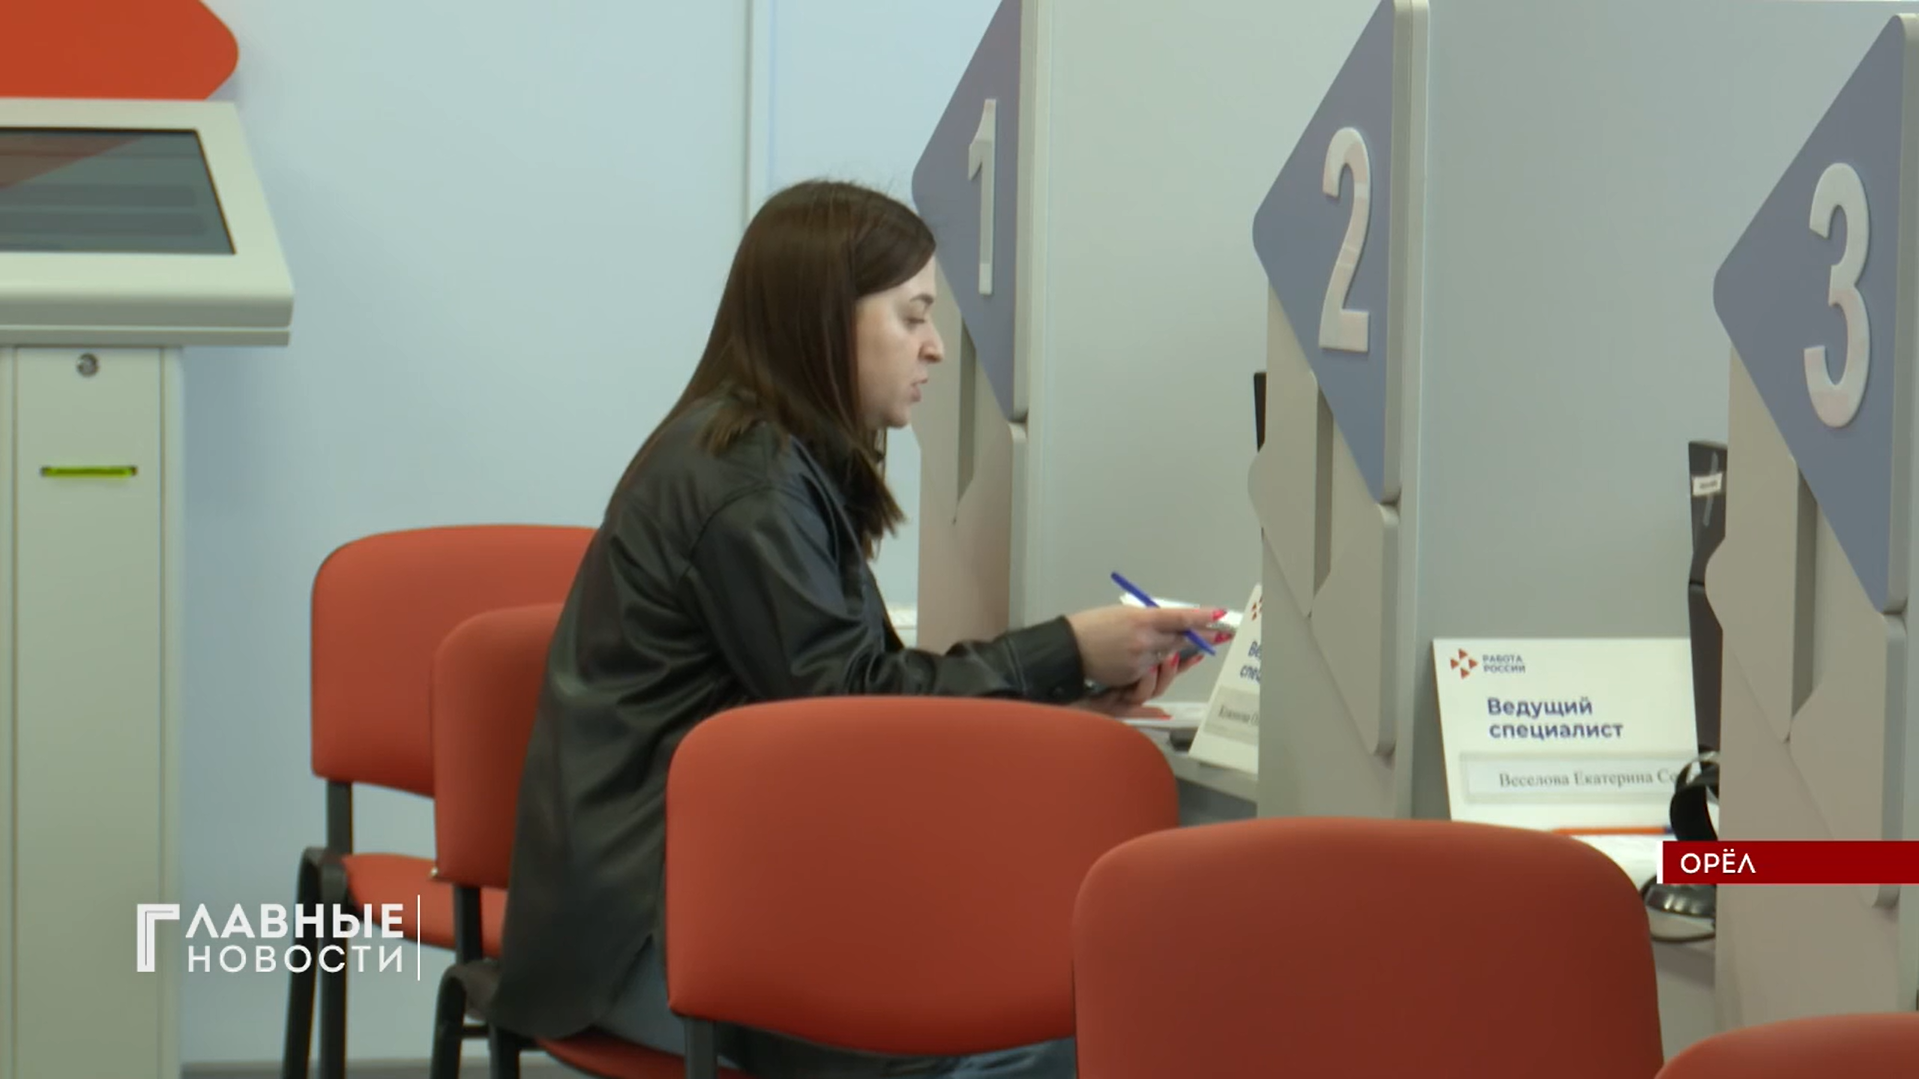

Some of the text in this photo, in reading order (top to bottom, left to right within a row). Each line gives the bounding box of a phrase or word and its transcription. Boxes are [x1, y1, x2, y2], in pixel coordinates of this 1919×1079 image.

[968, 98, 997, 295] 1
[1318, 126, 1371, 353] 2
[1803, 162, 1870, 428] 3
[1482, 654, 1523, 663] РАБОТА
[1483, 665, 1526, 674] РОССИИ
[1487, 696, 1593, 719] Ведущий
[1489, 723, 1623, 740] специалист
[1573, 770, 1654, 788] Екатерина
